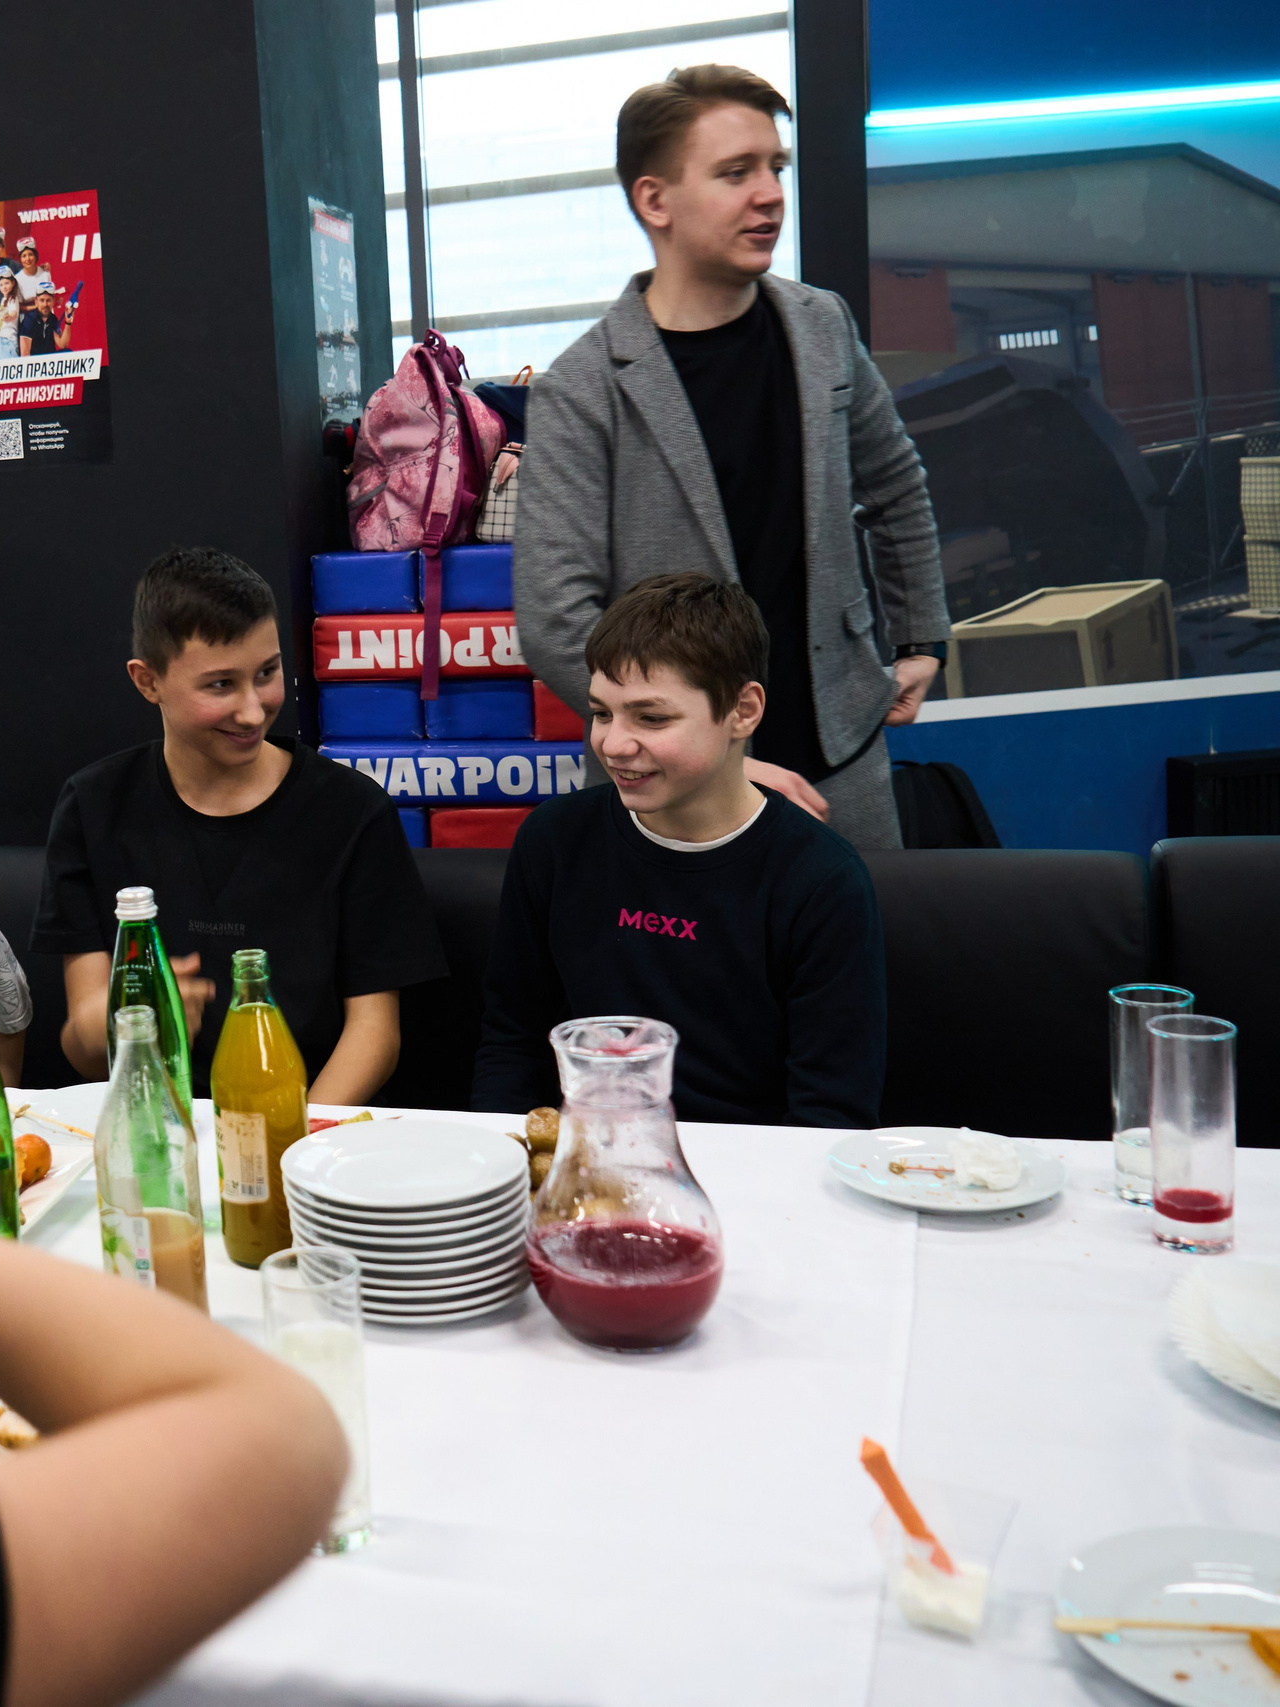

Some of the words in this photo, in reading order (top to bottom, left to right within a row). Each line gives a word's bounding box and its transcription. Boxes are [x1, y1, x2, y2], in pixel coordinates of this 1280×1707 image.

[17, 204, 90, 223] WARPOINT
[25, 357, 95, 378] ПРАЗДНИК?
[327, 626, 526, 670] RPOINT
[331, 755, 586, 797] WARPOIN
